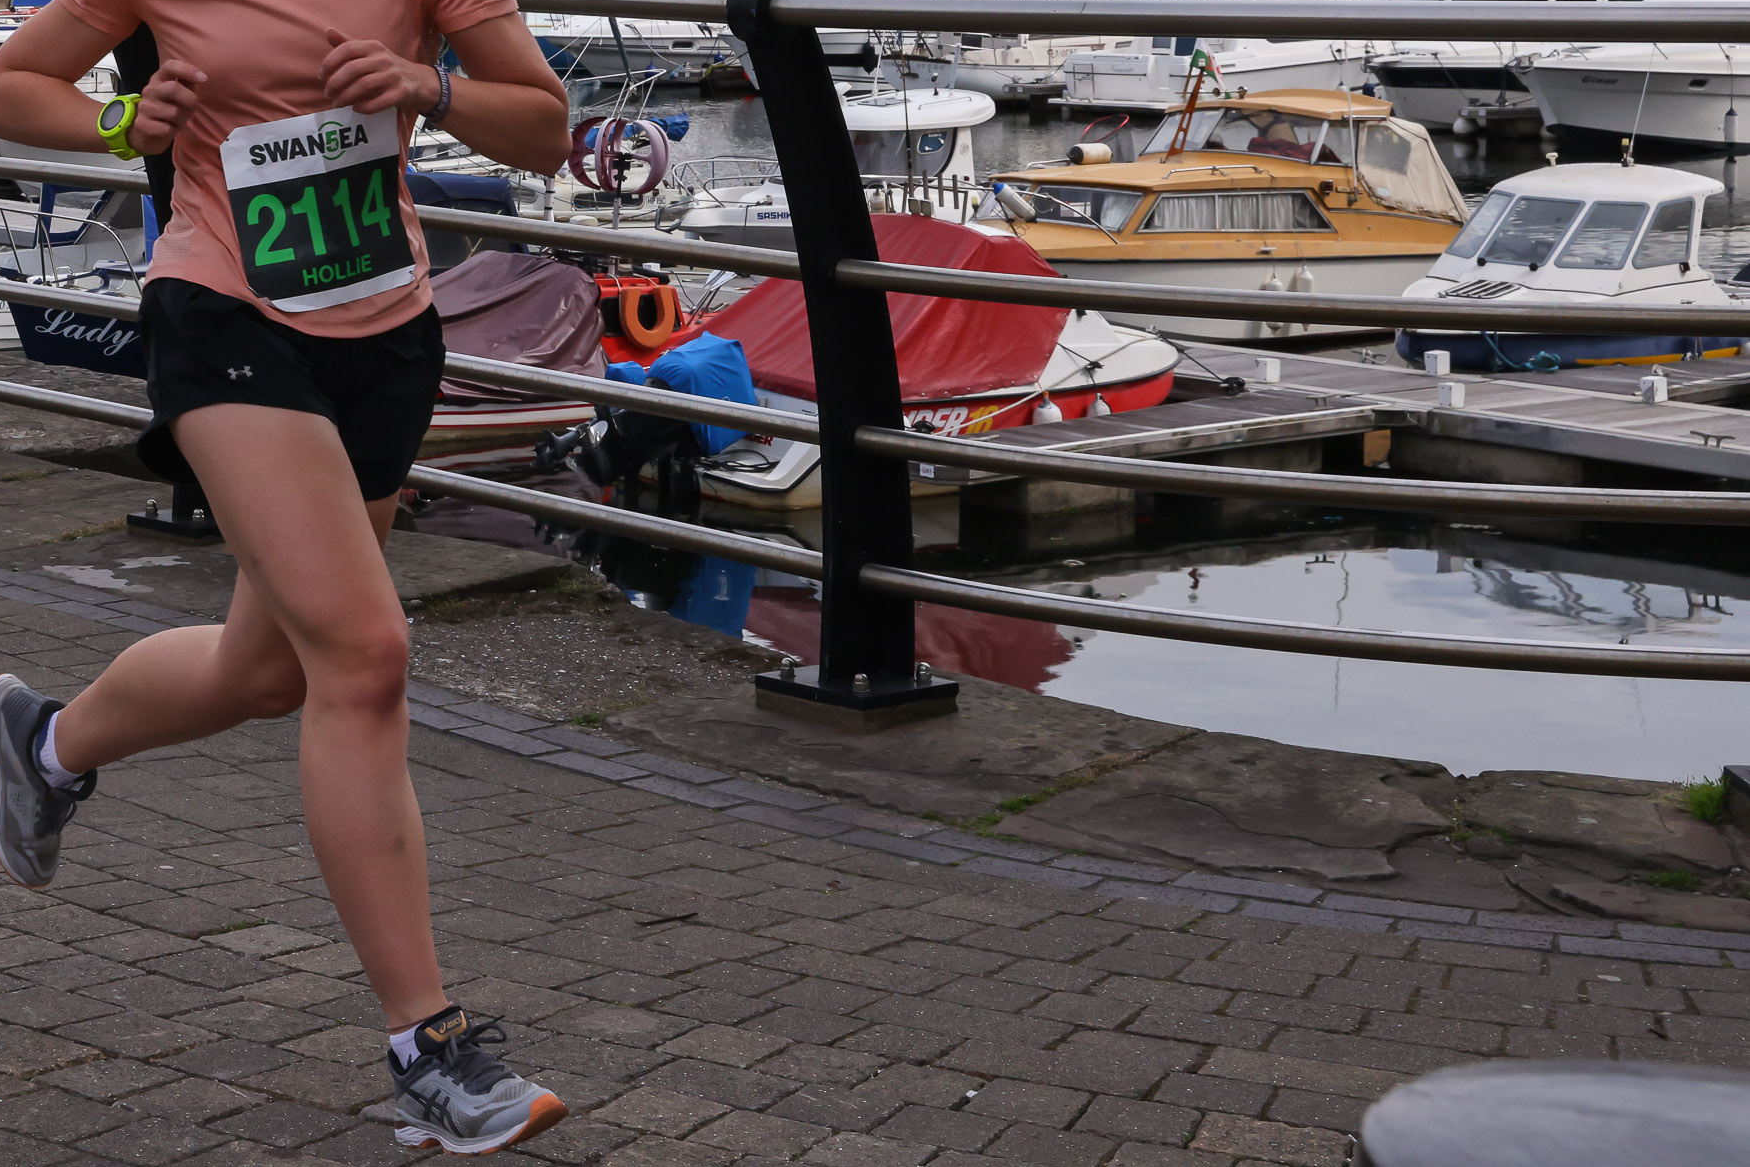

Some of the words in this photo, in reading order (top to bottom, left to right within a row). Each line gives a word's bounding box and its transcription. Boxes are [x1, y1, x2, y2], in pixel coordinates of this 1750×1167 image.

[247, 169, 392, 267] 2114
[302, 254, 373, 287] HOLLIE
[35, 308, 140, 356] Lady
